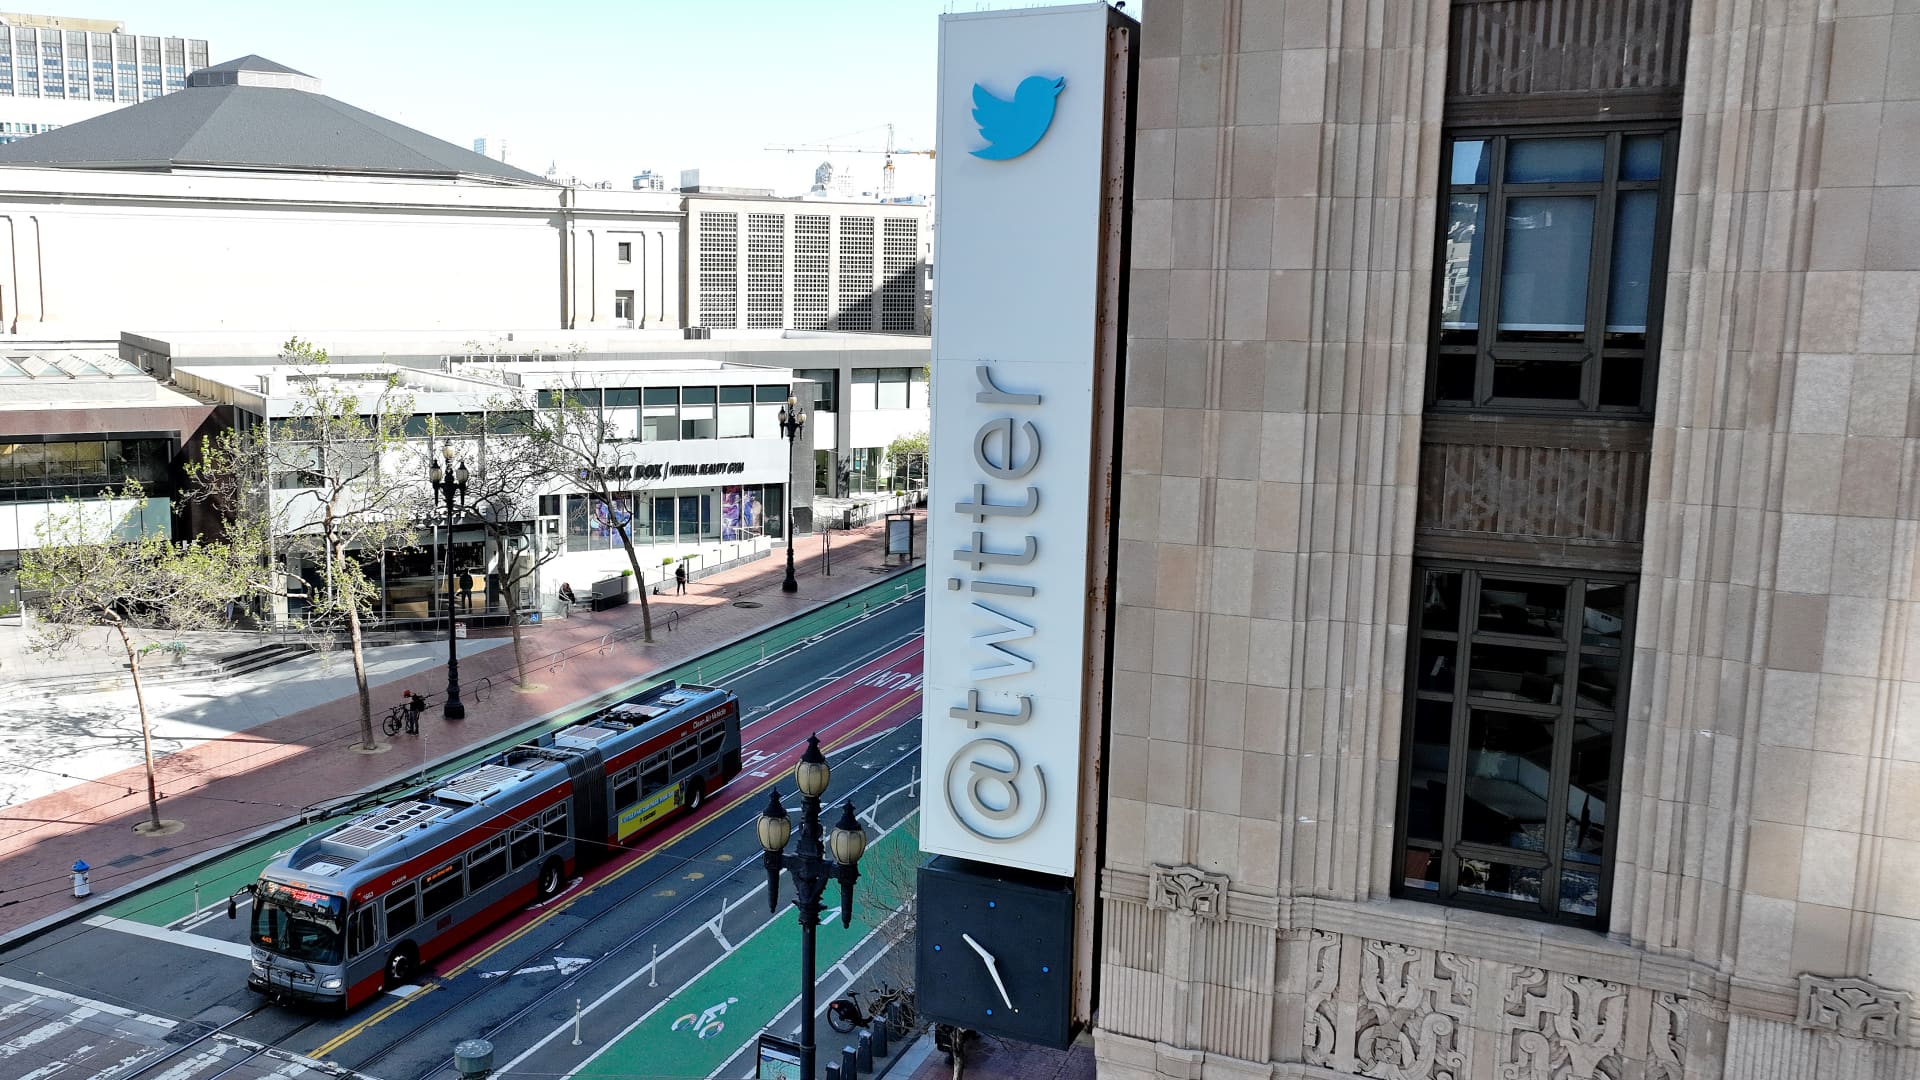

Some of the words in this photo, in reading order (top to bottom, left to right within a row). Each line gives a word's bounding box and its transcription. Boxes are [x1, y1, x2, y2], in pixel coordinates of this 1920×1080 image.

[669, 463, 699, 477] VIRTUAL
[699, 462, 729, 476] REALITY
[727, 462, 745, 475] GYM
[943, 364, 1047, 845] @twitter
